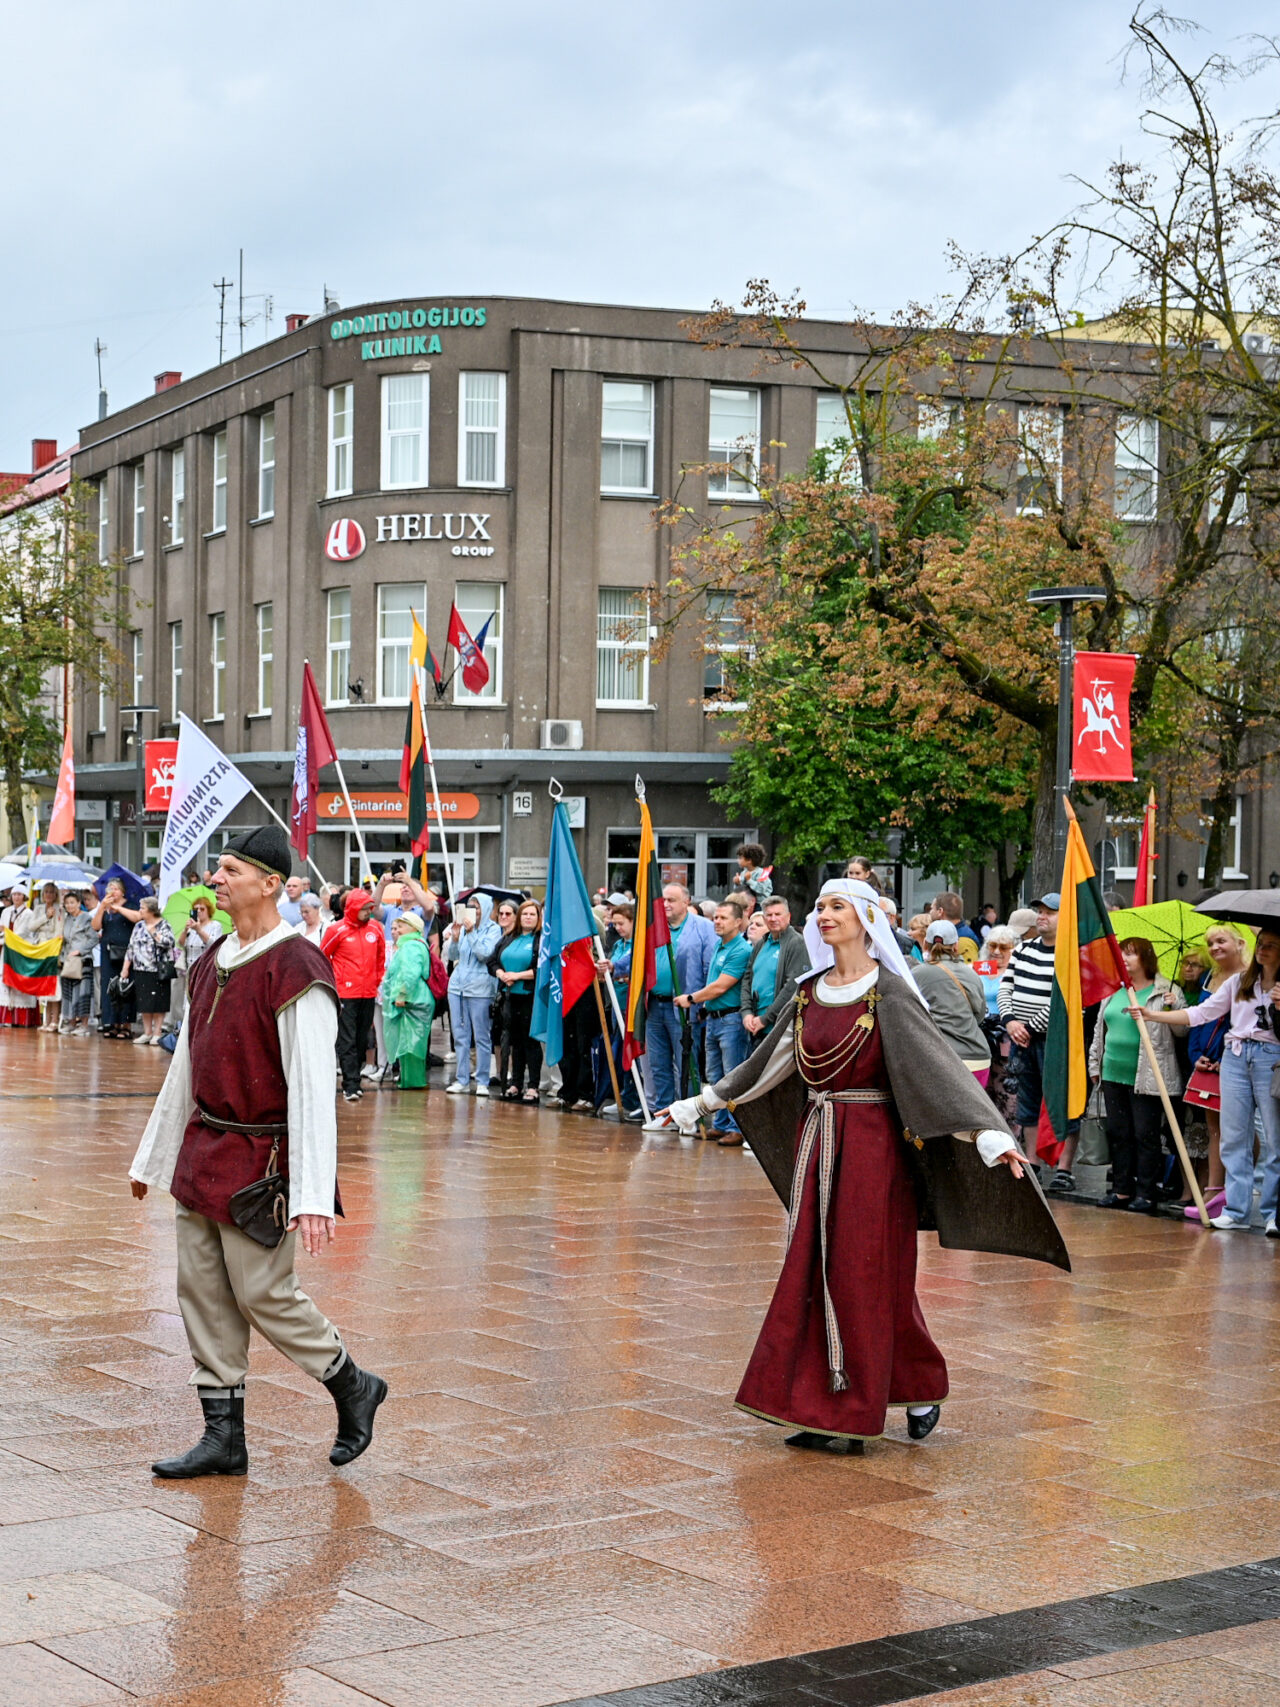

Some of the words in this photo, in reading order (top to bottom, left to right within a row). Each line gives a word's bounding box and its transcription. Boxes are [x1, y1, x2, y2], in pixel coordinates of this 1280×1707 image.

[330, 307, 487, 340] ODONTOLOGIJOS
[361, 334, 442, 360] KLINIKA
[375, 512, 492, 543] HELUX
[451, 545, 495, 557] GROUP
[350, 799, 403, 812] Gintarinė
[515, 796, 531, 809] 16
